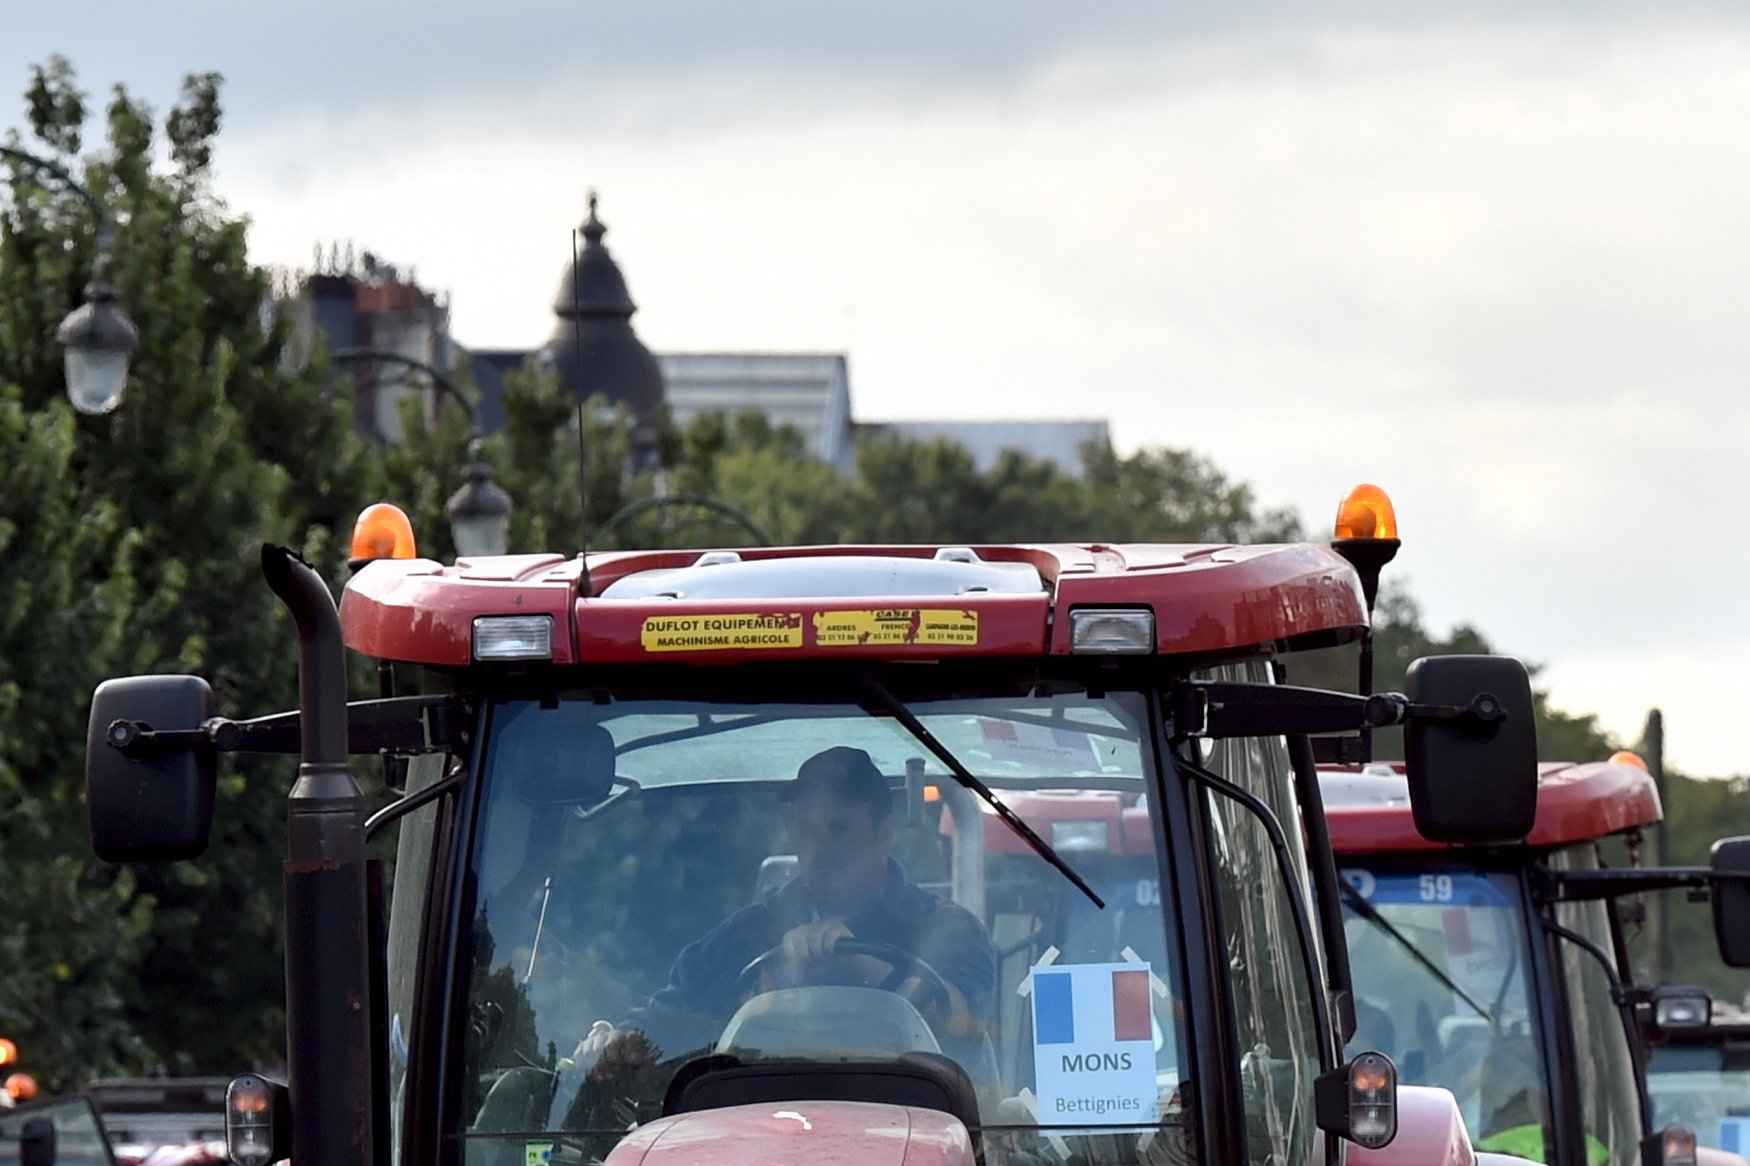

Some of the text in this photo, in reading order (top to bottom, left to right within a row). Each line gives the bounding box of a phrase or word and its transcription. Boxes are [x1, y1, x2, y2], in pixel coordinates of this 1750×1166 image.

[876, 610, 910, 618] CASE
[646, 617, 799, 632] DUFLOT EQUIPEMEN
[657, 634, 790, 647] MACHINISME AGRICOLE
[1419, 873, 1453, 901] 59
[1061, 1052, 1133, 1073] MONS
[1056, 1097, 1140, 1115] Bettignies
